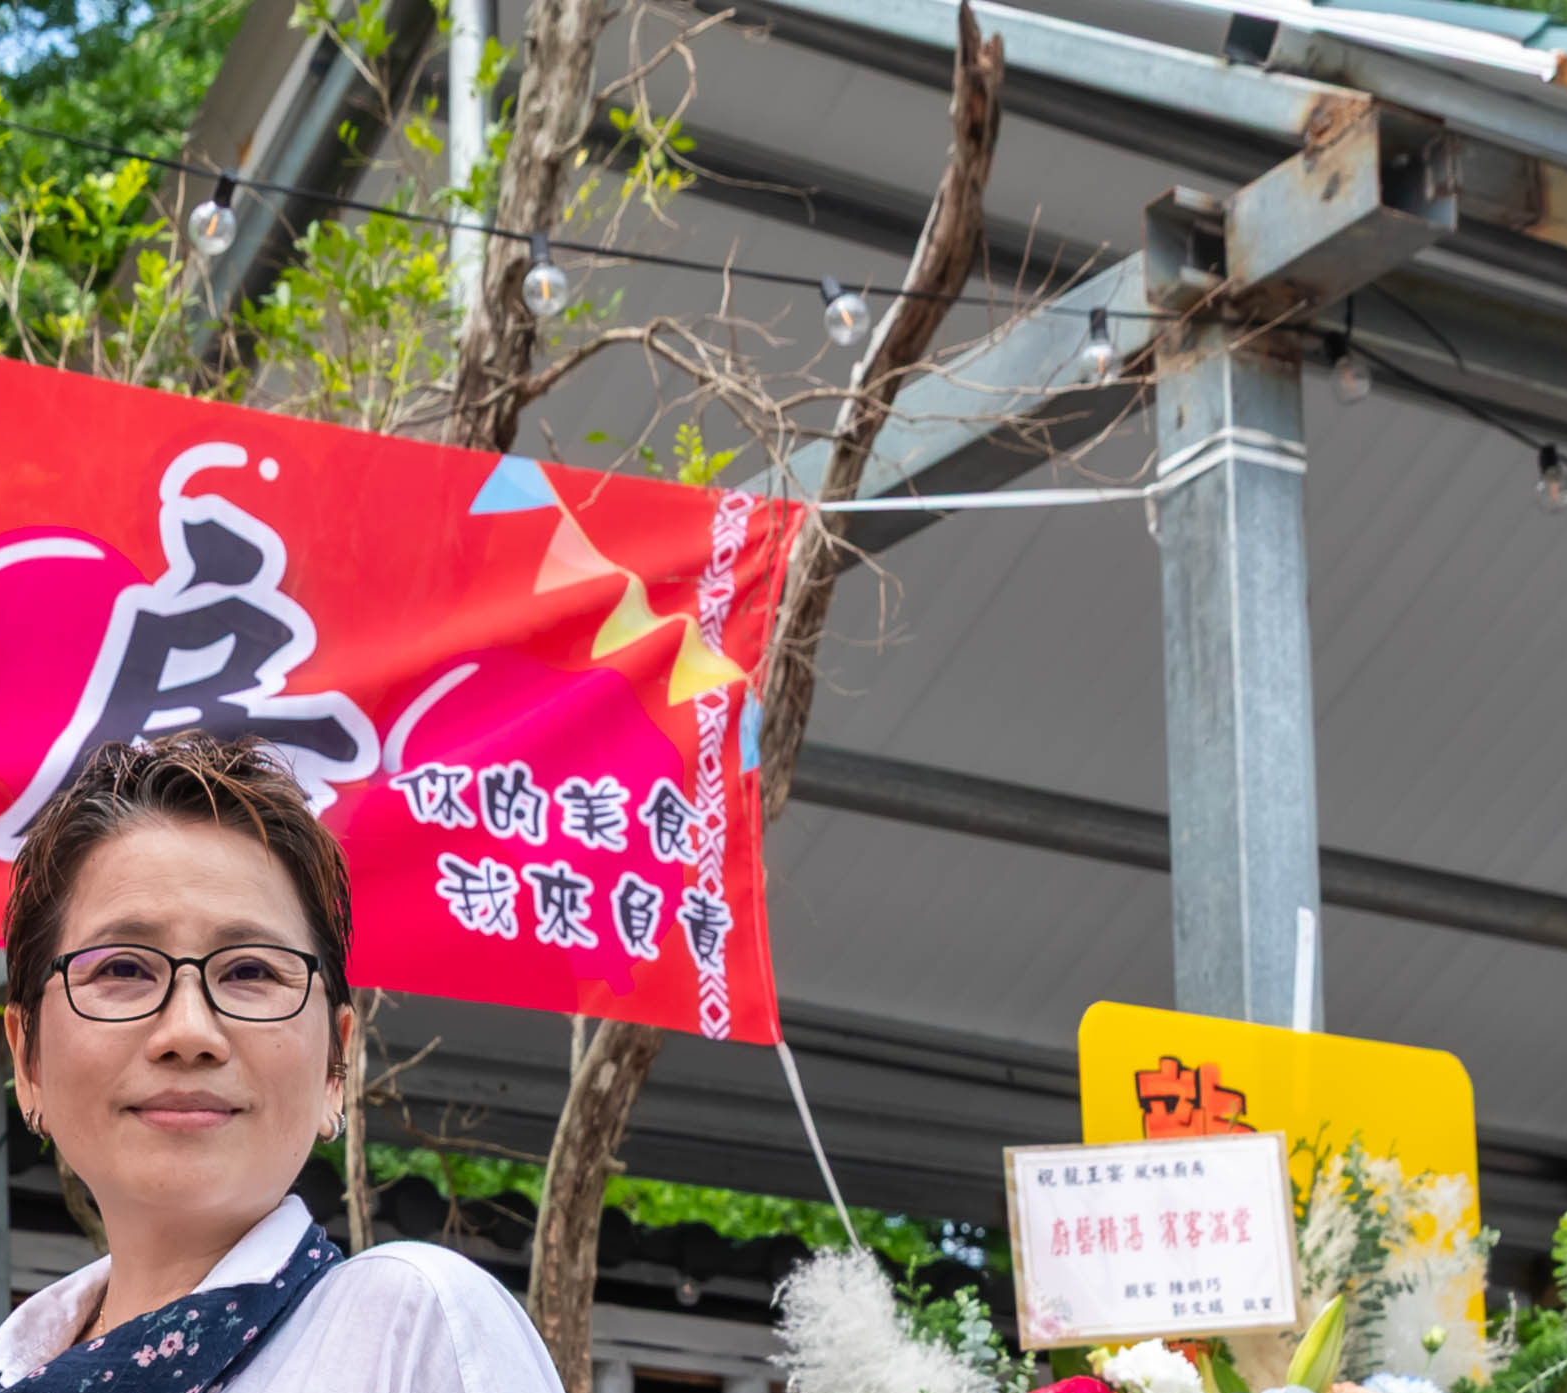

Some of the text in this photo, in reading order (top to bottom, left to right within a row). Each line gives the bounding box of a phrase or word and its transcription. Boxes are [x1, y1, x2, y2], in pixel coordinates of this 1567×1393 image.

[390, 759, 701, 863] 你的美食
[436, 851, 733, 969] 我來負責
